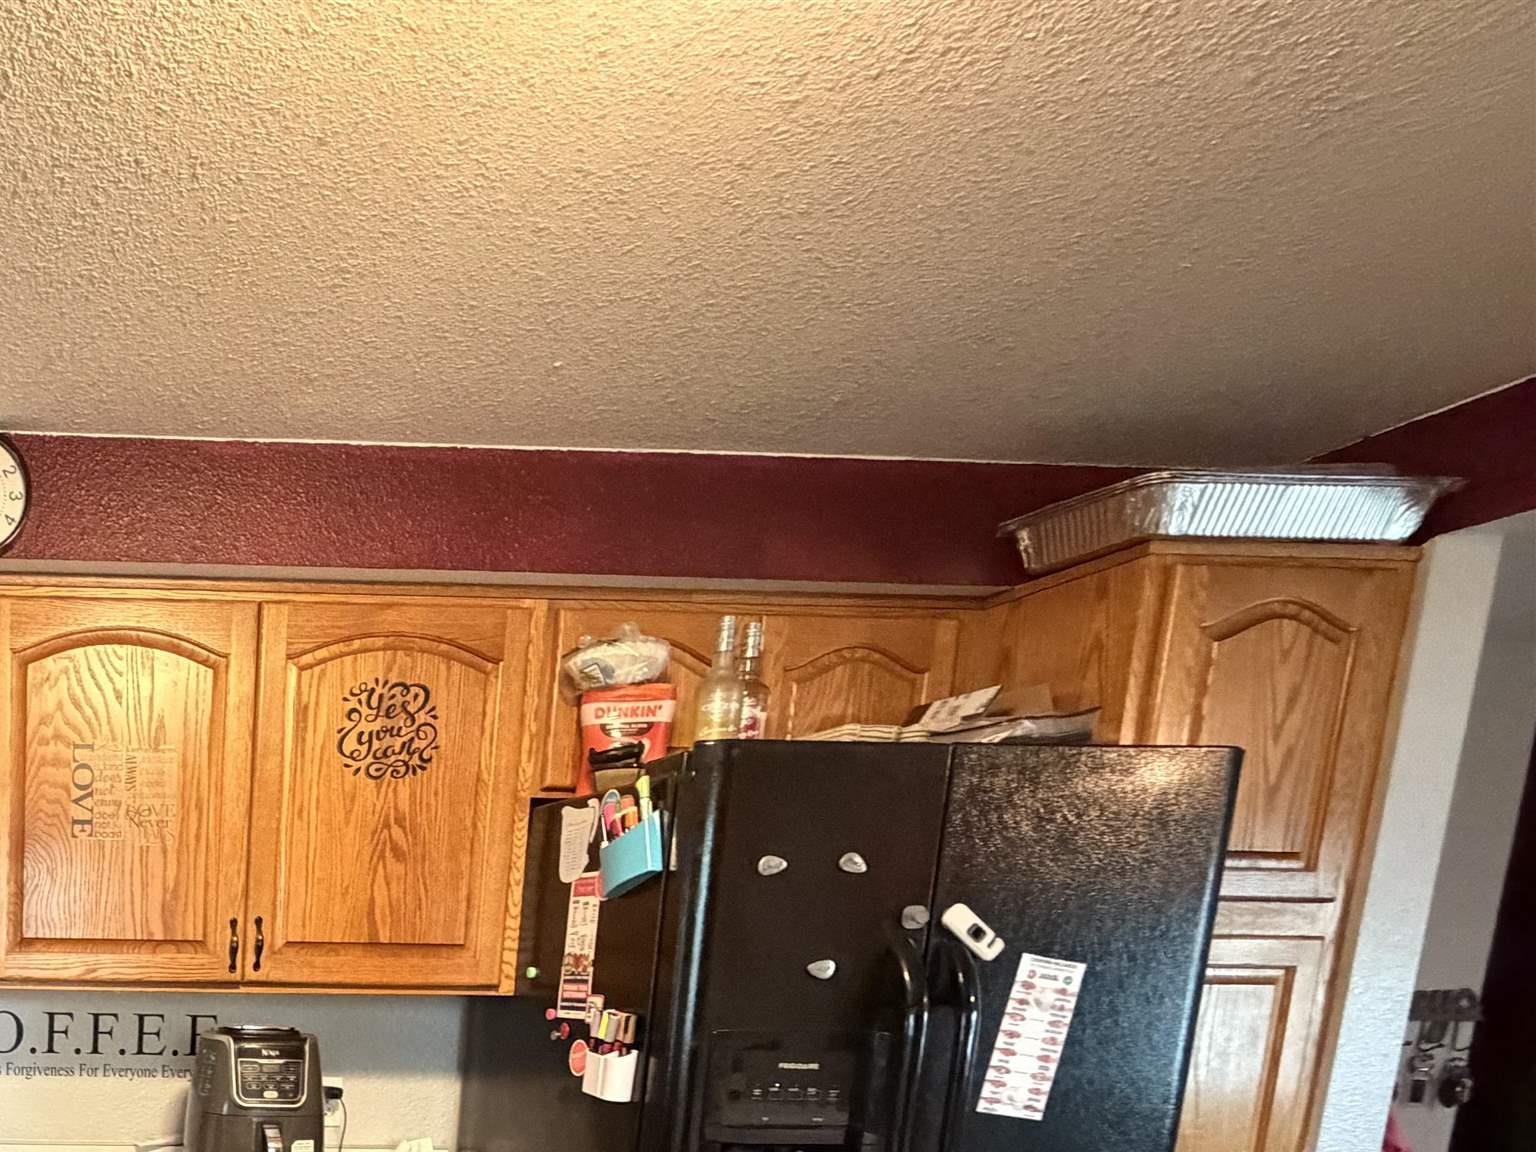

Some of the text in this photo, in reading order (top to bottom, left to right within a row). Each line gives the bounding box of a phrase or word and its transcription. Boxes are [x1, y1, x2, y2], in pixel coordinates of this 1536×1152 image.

[2, 465, 17, 479] 2
[8, 490, 23, 501] 3
[4, 514, 17, 526] 4
[351, 681, 430, 728] Yes
[70, 741, 95, 838] LOVE
[5, 1062, 75, 1080] Forgiveness
[78, 1063, 100, 1077] For
[103, 1063, 158, 1081] Everyone
